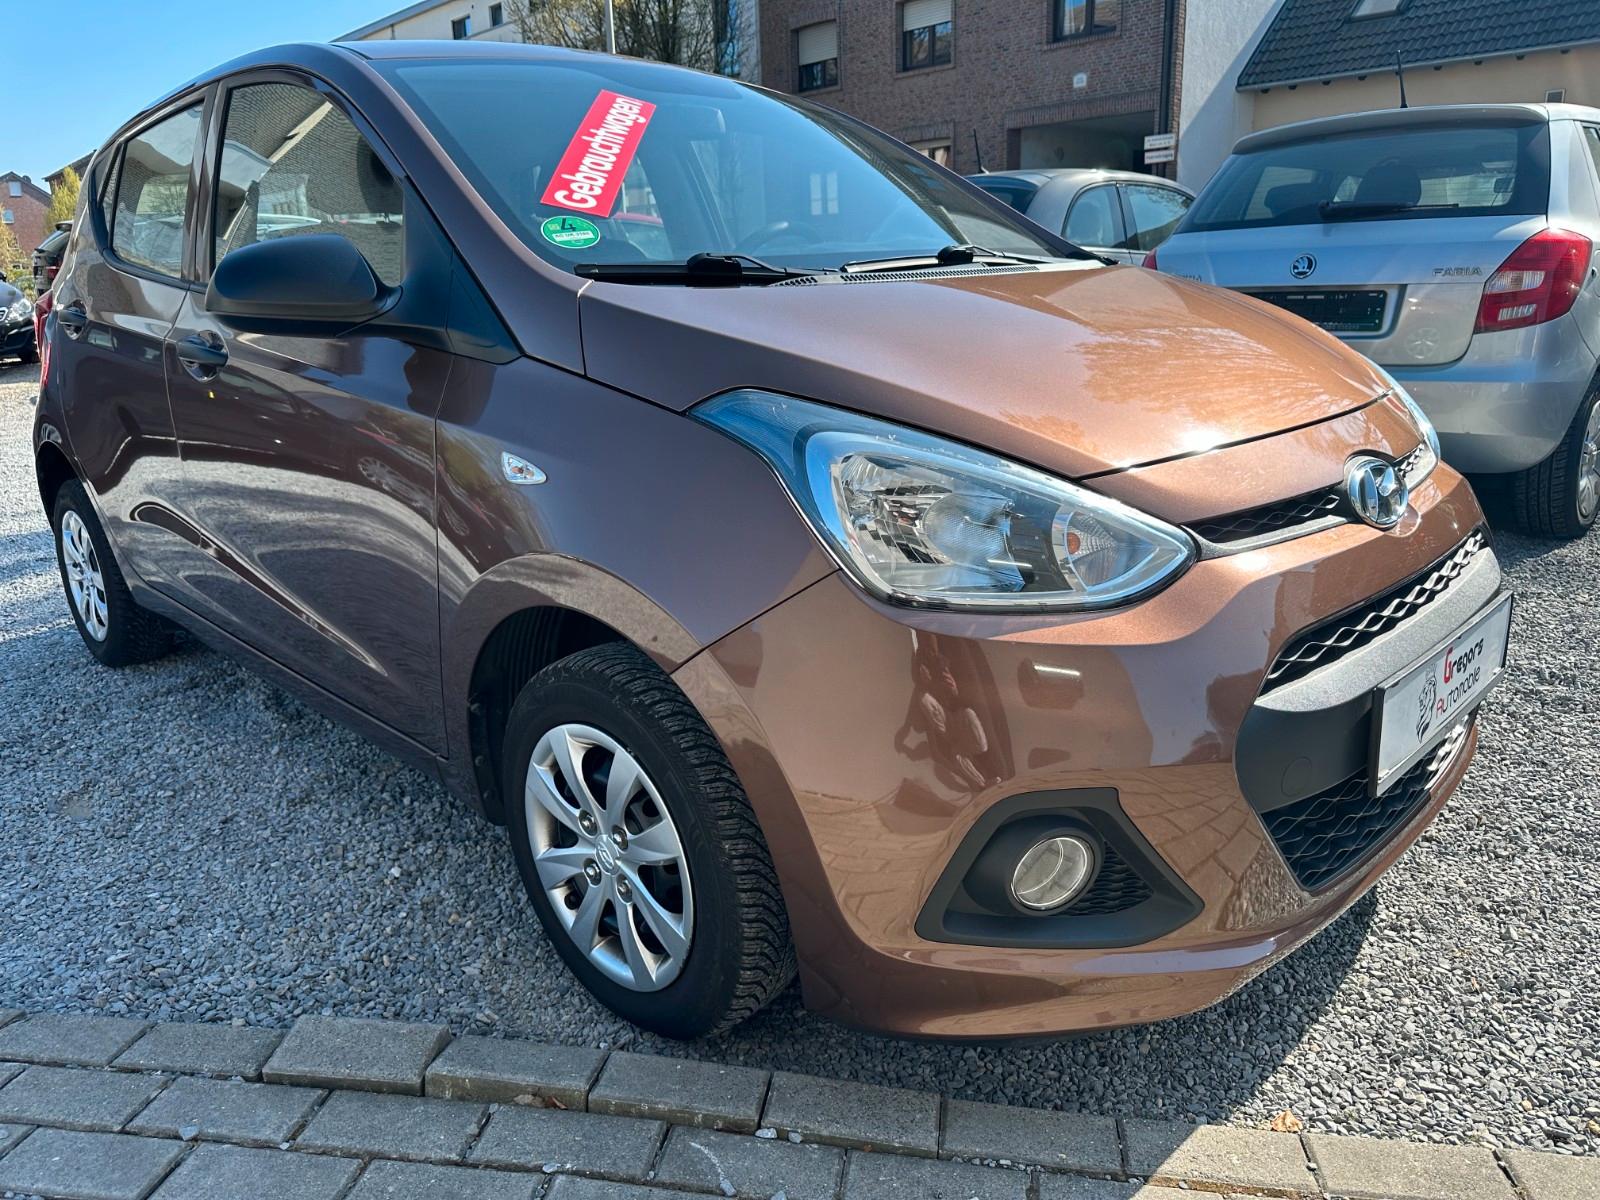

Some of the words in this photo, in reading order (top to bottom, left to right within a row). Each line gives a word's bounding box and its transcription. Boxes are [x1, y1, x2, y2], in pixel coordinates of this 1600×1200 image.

[553, 97, 646, 208] Gebrauchtwagen
[560, 217, 577, 231] 4
[1431, 266, 1483, 277] FABIA
